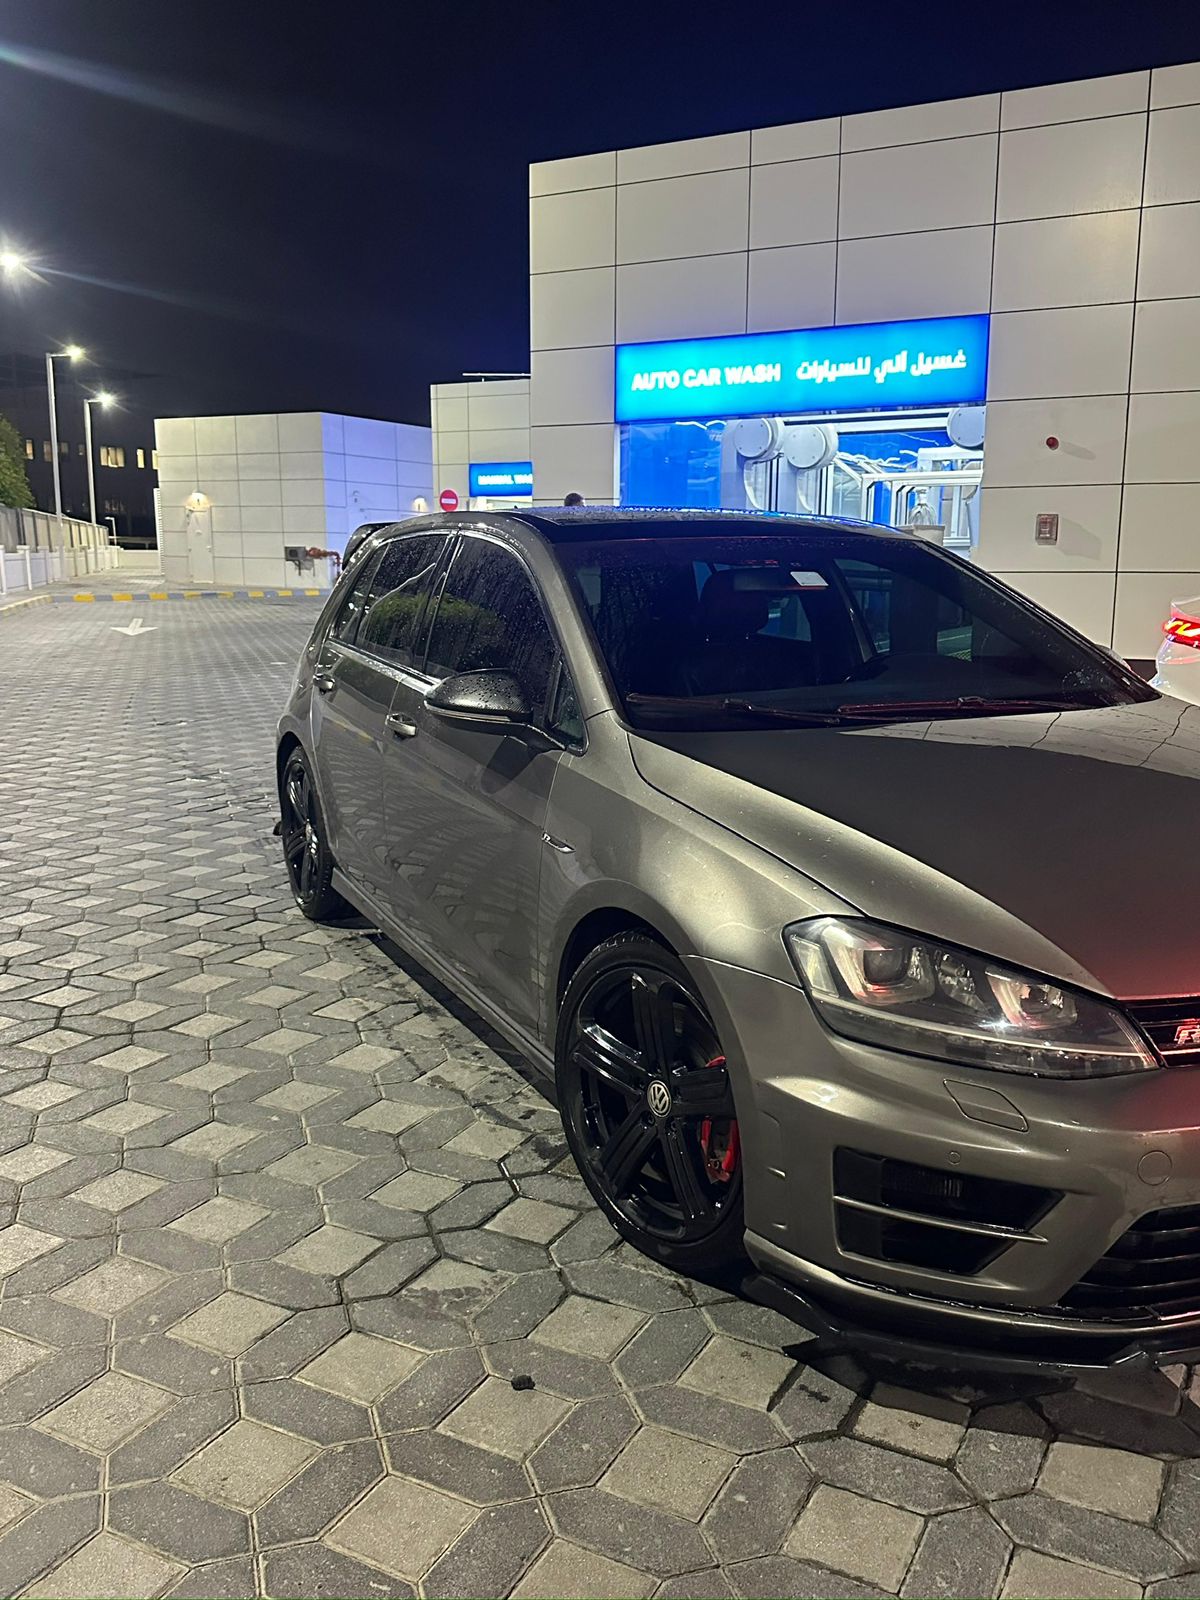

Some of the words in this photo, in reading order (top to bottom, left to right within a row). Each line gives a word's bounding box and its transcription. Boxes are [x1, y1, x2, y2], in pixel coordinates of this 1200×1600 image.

[632, 370, 680, 391] AUTO
[683, 367, 721, 388] CAR
[724, 363, 781, 385] WASH
[796, 356, 871, 384] للسيارات
[910, 349, 967, 377] غسيل
